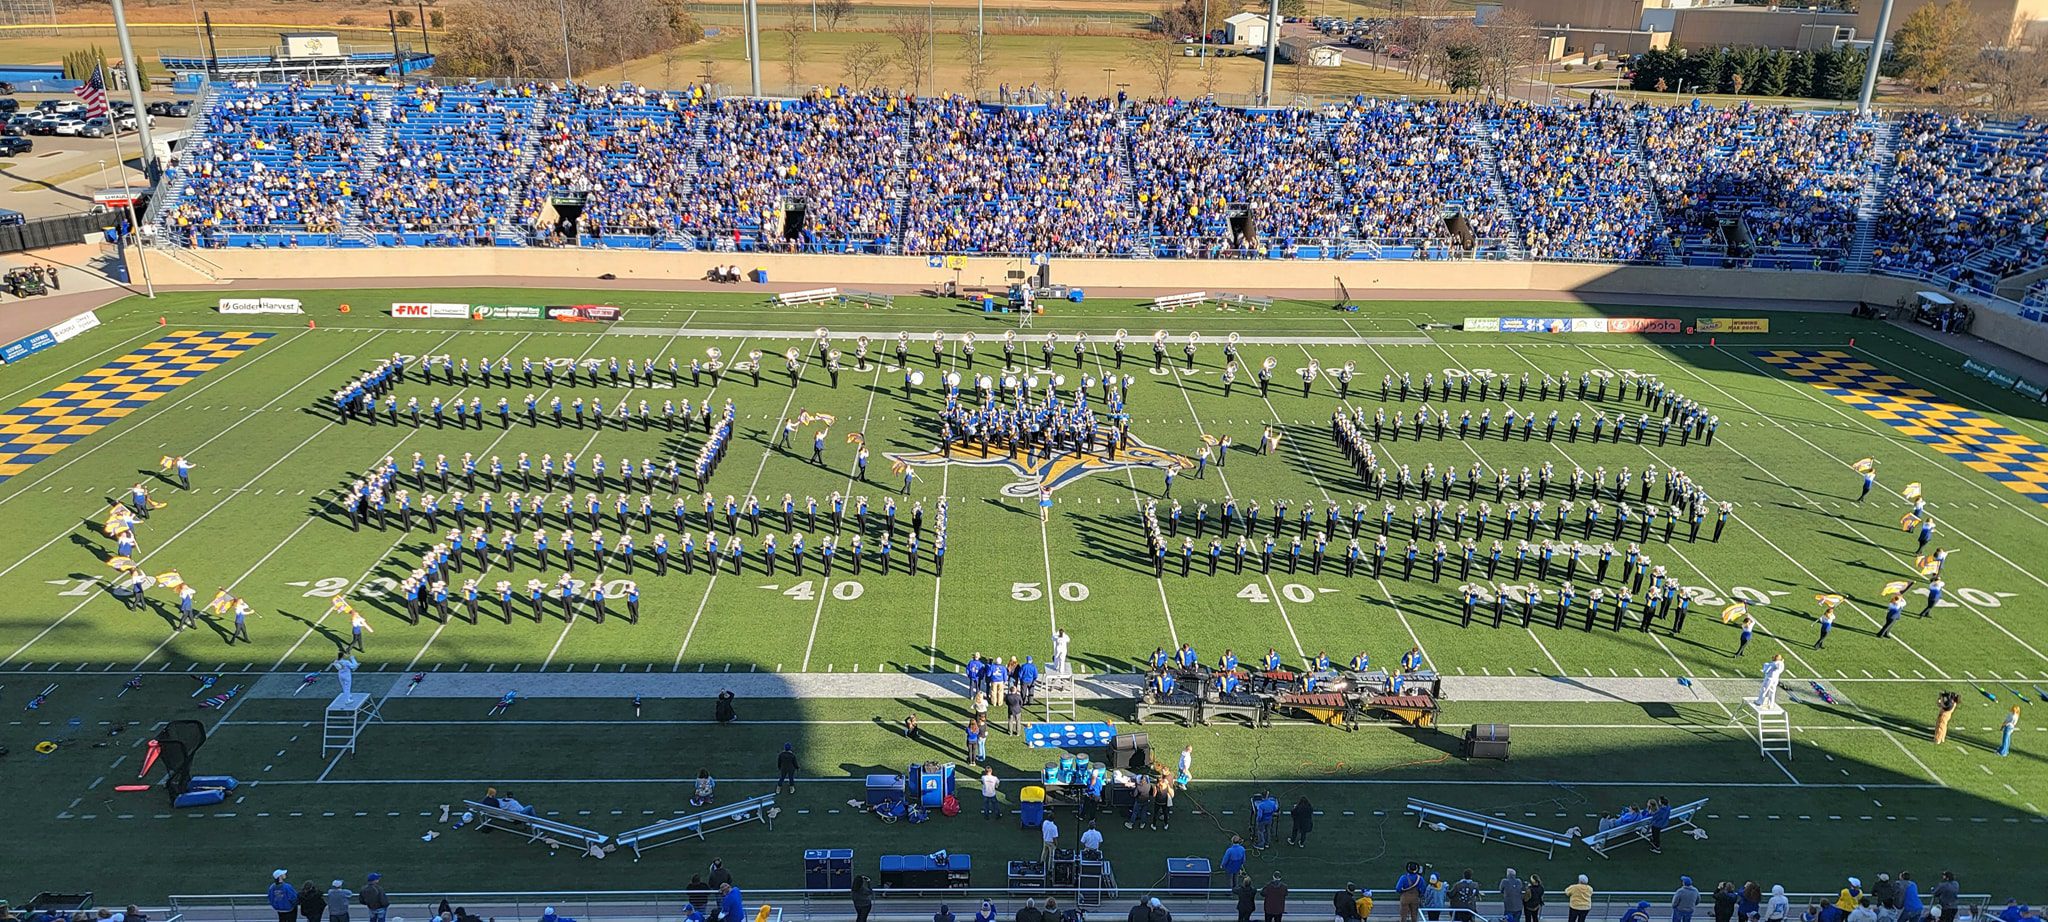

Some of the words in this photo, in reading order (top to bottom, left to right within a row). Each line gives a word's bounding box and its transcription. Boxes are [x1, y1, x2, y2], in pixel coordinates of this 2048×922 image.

[262, 302, 294, 310] Harvest
[395, 305, 428, 315] FMC
[782, 581, 864, 600] 40
[1011, 582, 1090, 601] 50
[1236, 583, 1315, 603] 40
